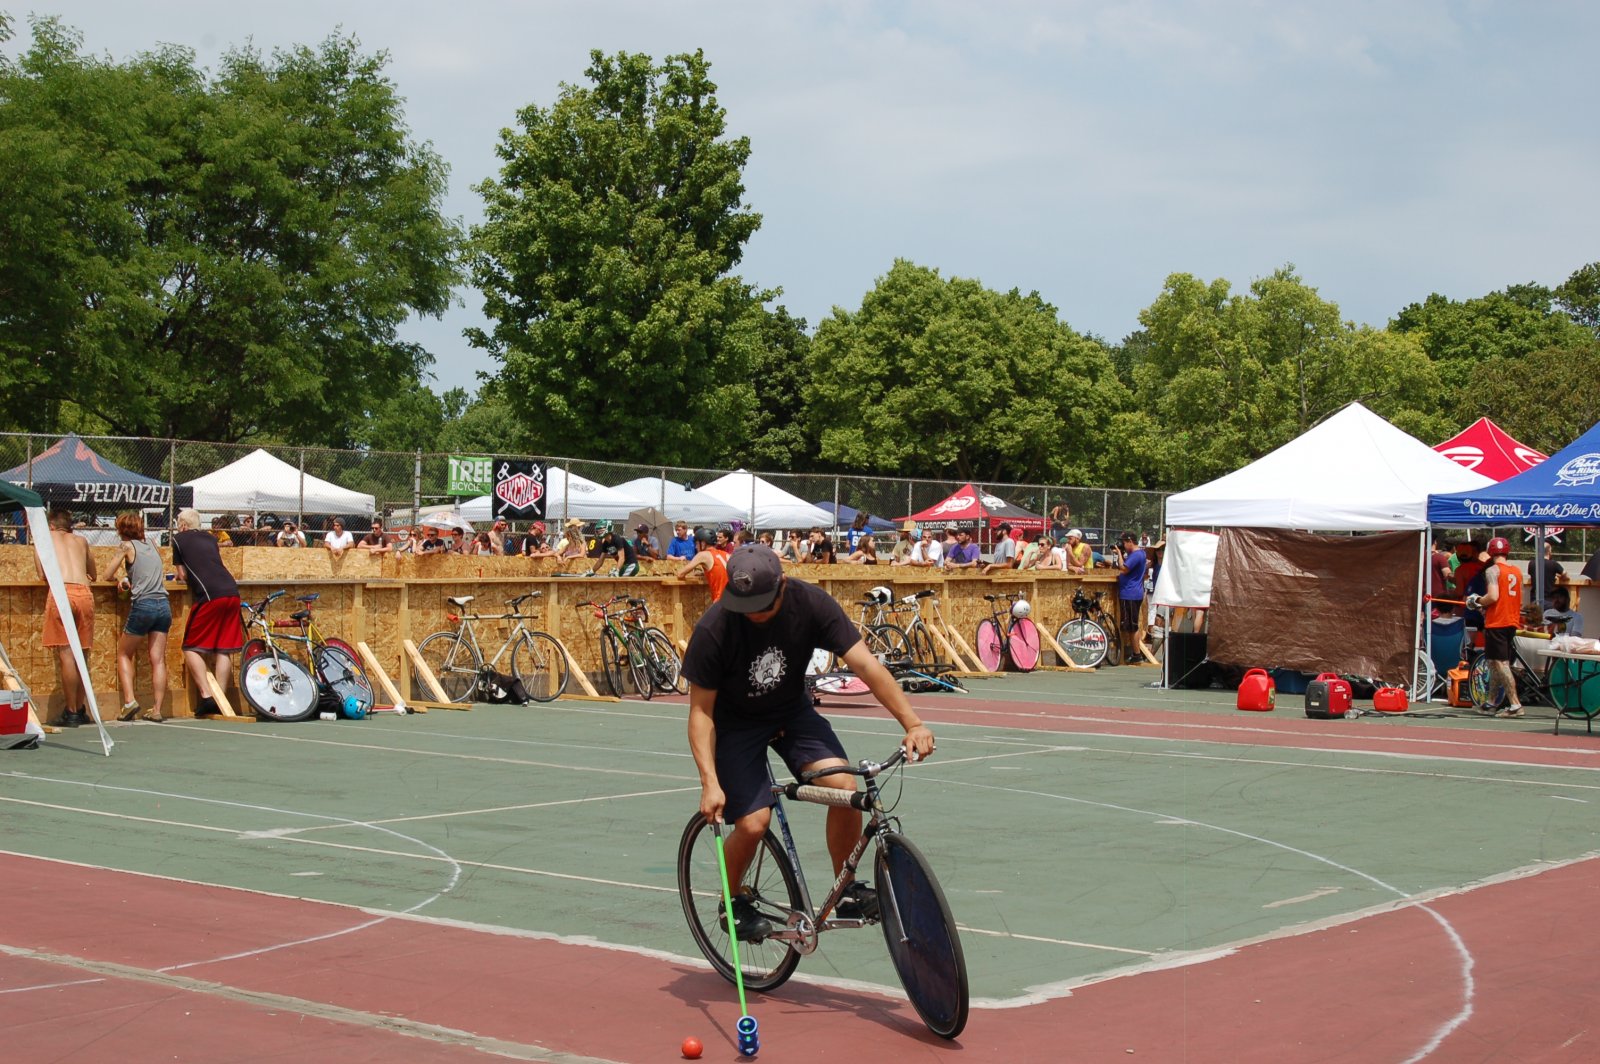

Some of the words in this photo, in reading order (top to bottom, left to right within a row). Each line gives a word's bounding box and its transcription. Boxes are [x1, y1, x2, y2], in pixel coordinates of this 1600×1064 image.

[449, 459, 492, 483] TREE
[72, 482, 171, 505] SPECIALIZED
[451, 482, 481, 492] BICYCLE
[500, 478, 541, 505] FIXCRAFT
[1470, 501, 1524, 518] ORIGINAL
[1523, 503, 1559, 518] Pabst
[1556, 503, 1588, 518] Blue
[1508, 573, 1517, 597] 2
[834, 840, 862, 891] Biachi
